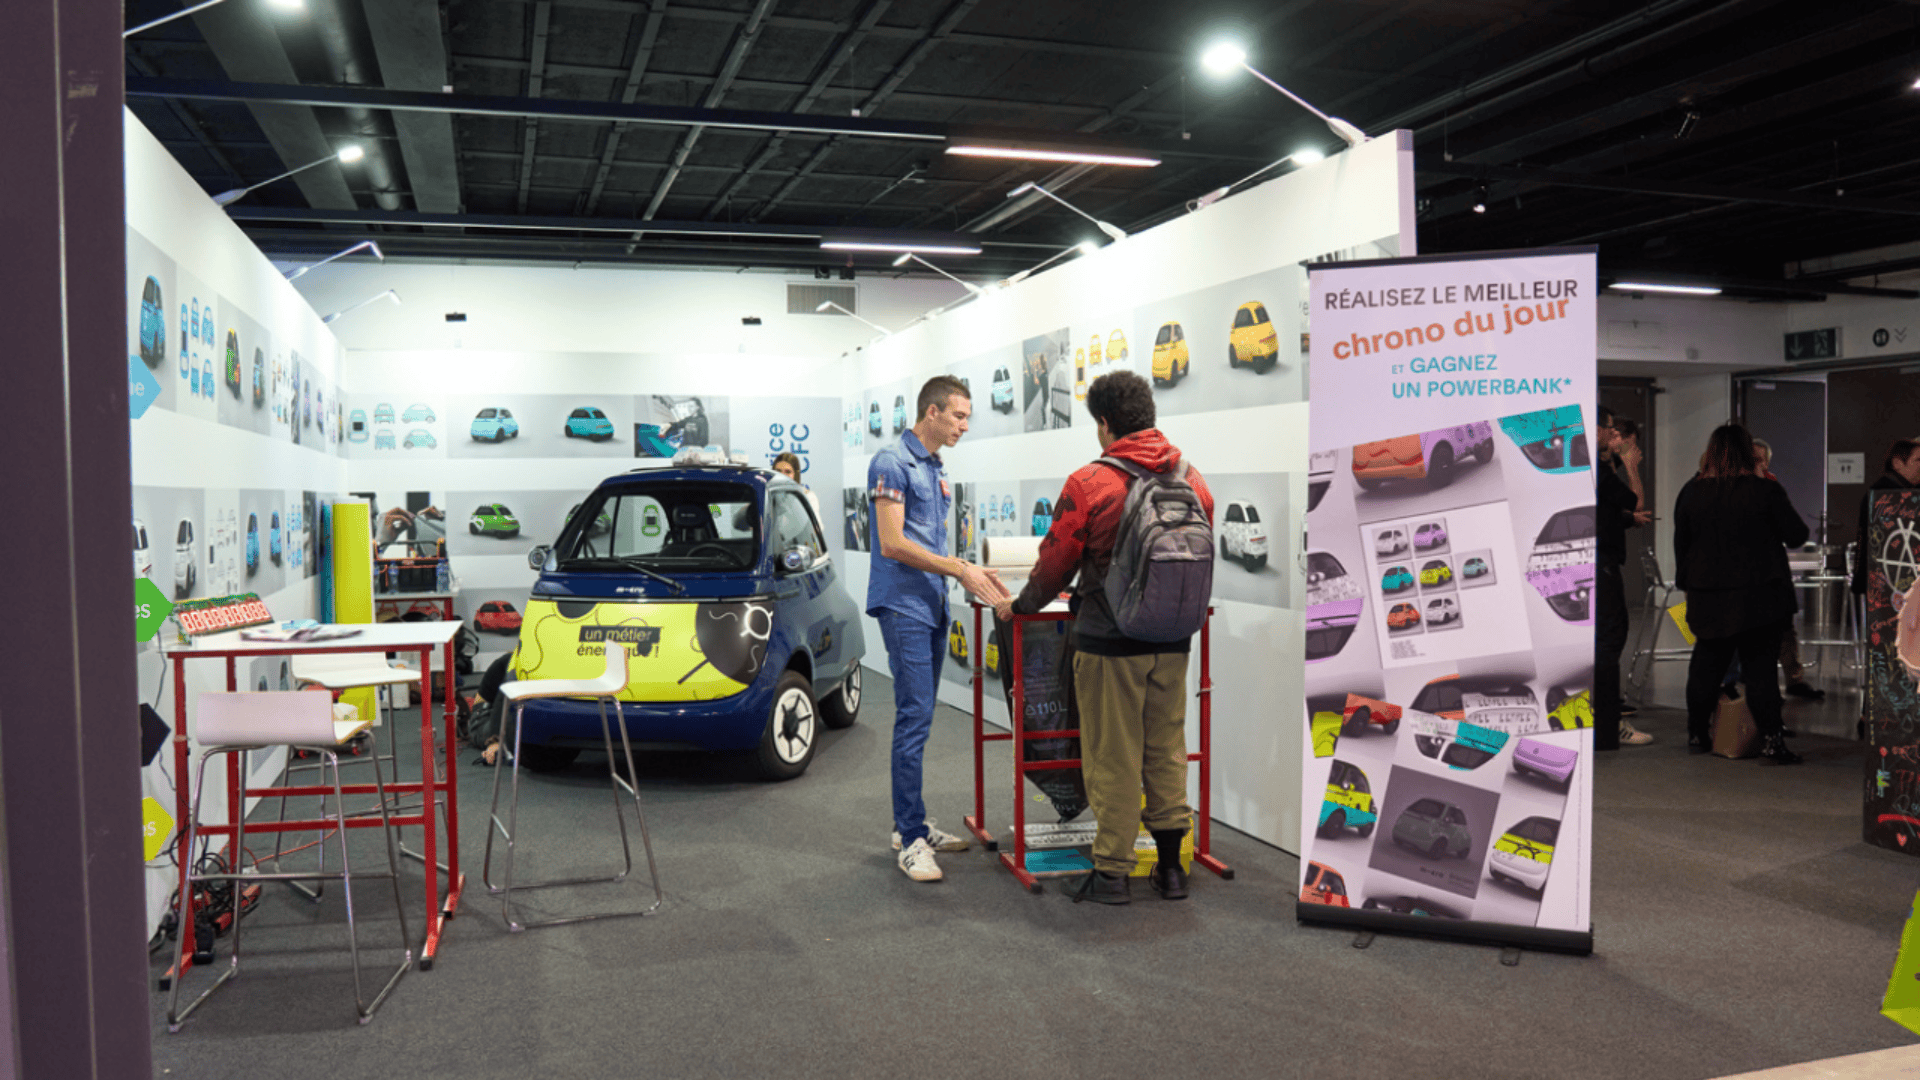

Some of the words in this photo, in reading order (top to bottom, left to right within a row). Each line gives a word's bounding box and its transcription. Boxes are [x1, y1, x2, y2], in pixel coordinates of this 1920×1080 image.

[1325, 287, 1425, 310] RÉALISEZ
[1433, 286, 1457, 304] LE
[1464, 279, 1578, 302] MEILLEUR
[1333, 322, 1445, 360] chrono
[1454, 310, 1495, 337] du
[1503, 298, 1569, 335] jour
[1391, 364, 1404, 374] ET
[1410, 354, 1498, 374] GAGNEZ
[1392, 382, 1421, 398] UN
[765, 423, 784, 466] ice
[584, 629, 603, 640] un
[606, 627, 653, 641] métier
